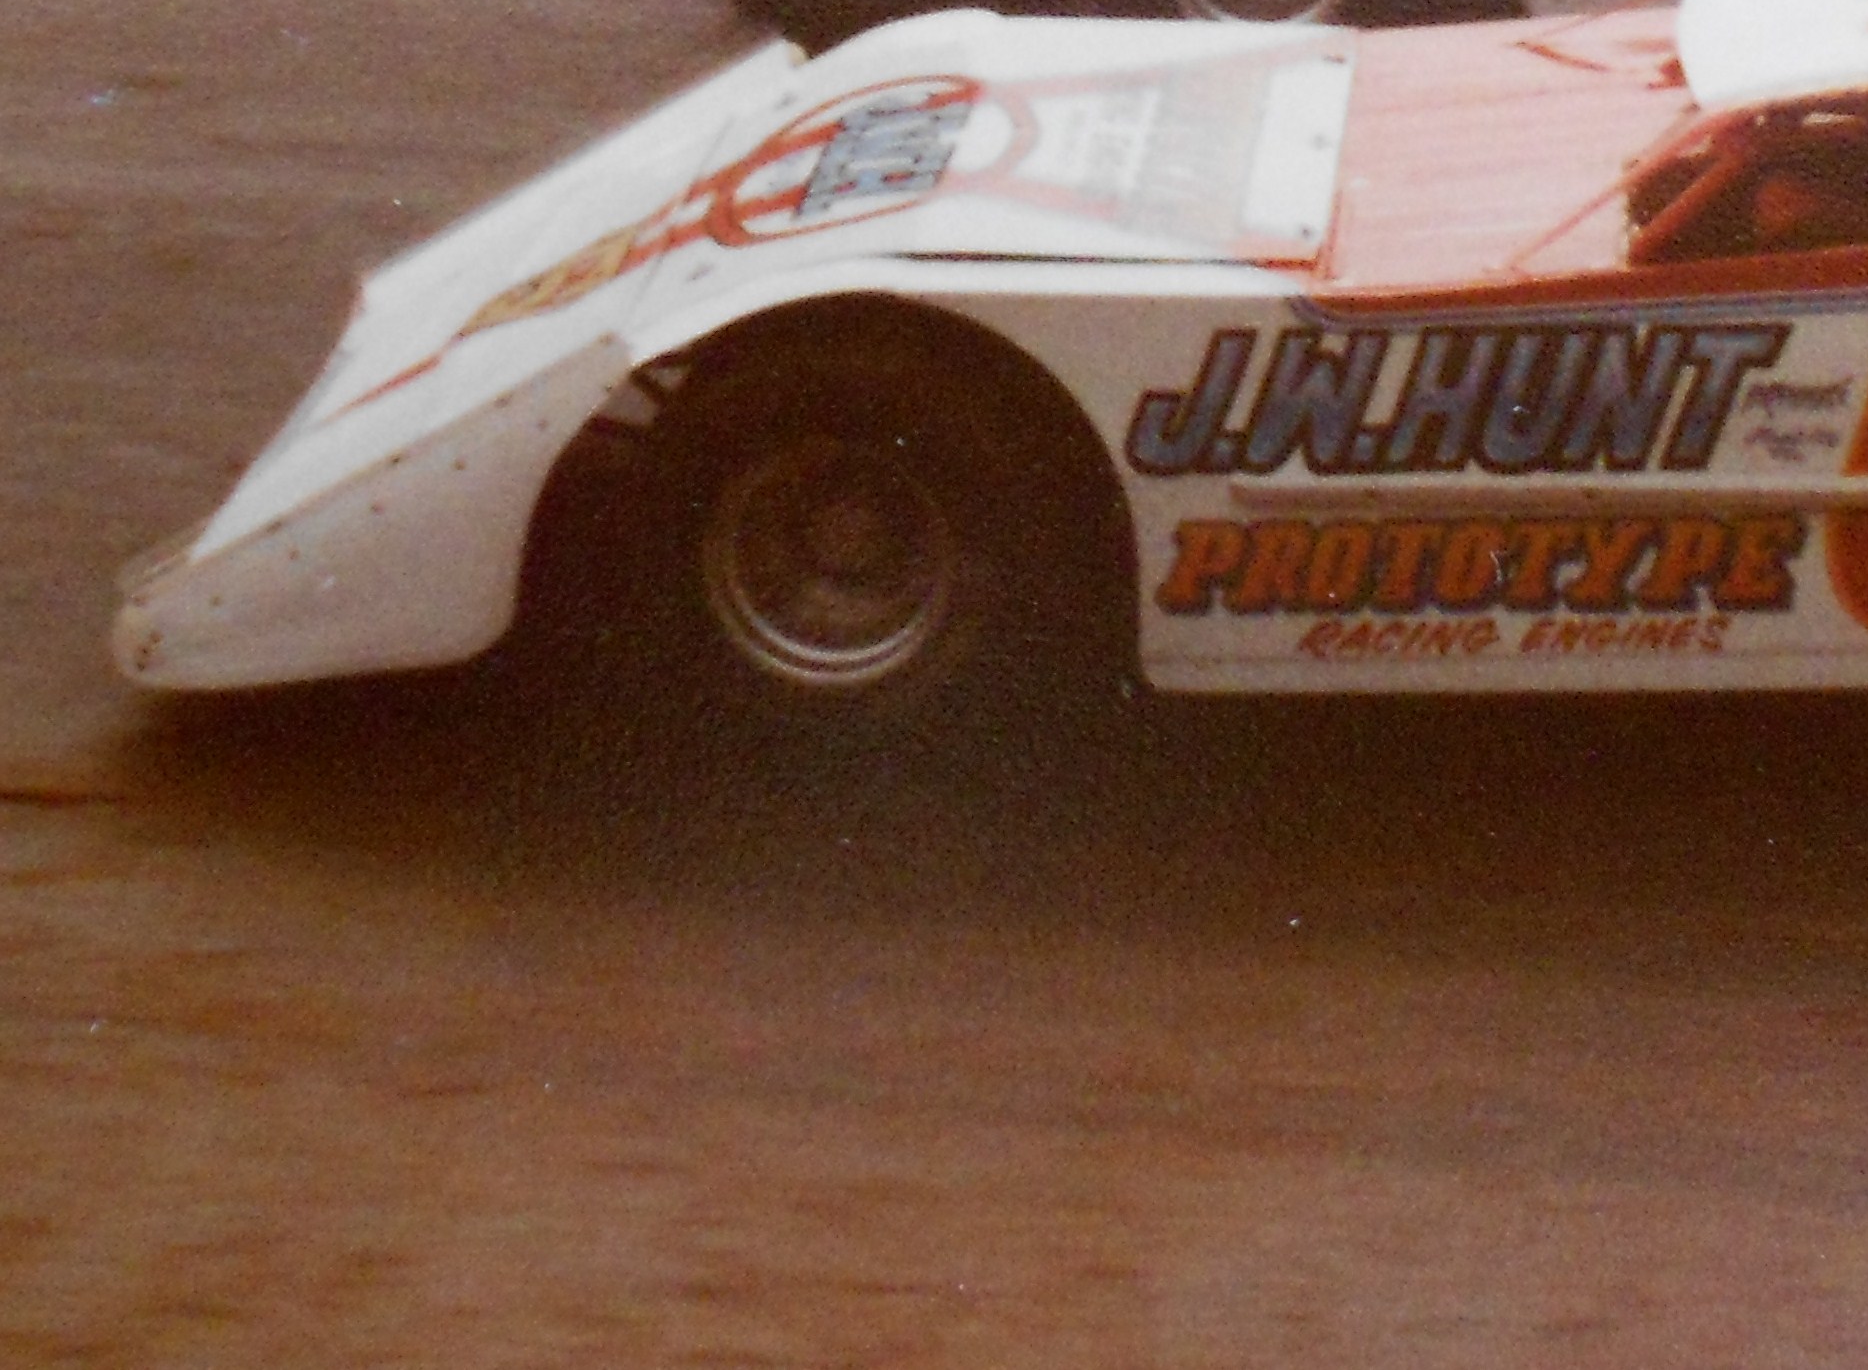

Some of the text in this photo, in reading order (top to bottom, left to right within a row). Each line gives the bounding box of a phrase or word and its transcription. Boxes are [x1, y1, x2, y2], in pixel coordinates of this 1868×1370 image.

[1155, 510, 1804, 618] PROTOTYPE
[1298, 614, 1732, 660] RACING ENGINES
